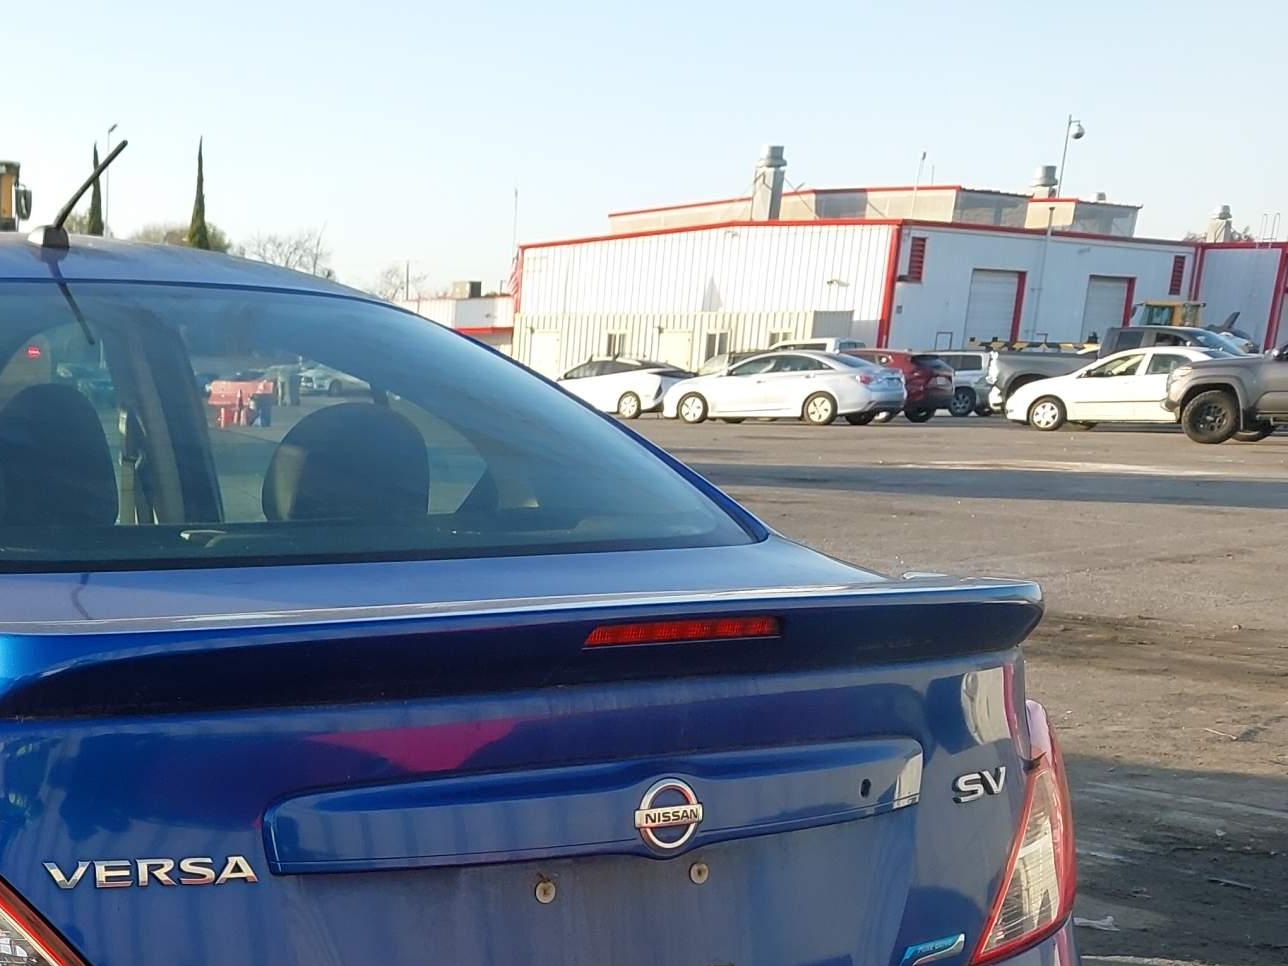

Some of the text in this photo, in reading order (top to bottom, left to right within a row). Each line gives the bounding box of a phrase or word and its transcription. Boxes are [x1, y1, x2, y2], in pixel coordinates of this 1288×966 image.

[954, 766, 1006, 803] SV
[645, 809, 698, 824] NISSAN
[42, 855, 259, 889] VERSA
